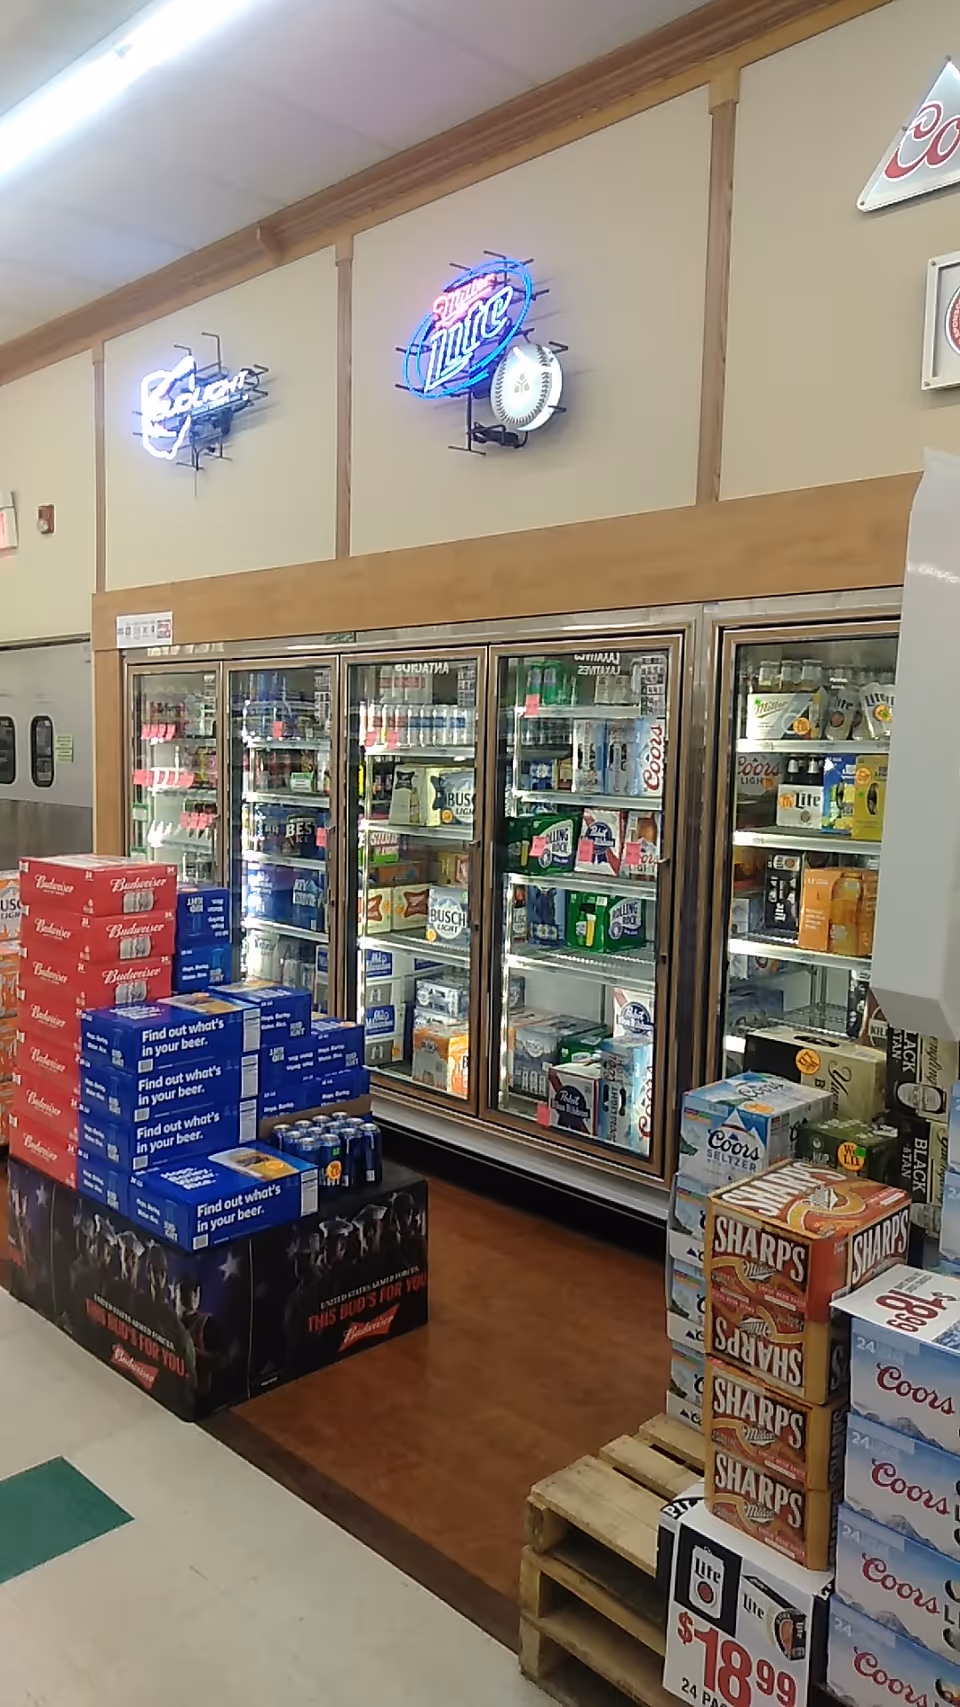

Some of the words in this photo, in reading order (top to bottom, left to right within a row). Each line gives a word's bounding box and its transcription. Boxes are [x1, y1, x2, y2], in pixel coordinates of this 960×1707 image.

[424, 285, 513, 393] Lite
[643, 724, 663, 791] Coors
[740, 776, 763, 785] LIGH
[447, 793, 472, 807] BUS
[794, 792, 821, 809] Lite
[35, 874, 74, 893] Budweiser
[110, 877, 166, 893] Budweiser
[430, 909, 466, 928] BUSCH
[775, 902, 786, 921] Lite
[35, 918, 71, 939] Budweiser
[106, 922, 164, 938] Budweiser
[33, 961, 68, 983] Budweiser
[102, 967, 161, 984] Budweiser
[31, 1003, 66, 1028] Budweiser
[142, 1027, 167, 1043] Find
[168, 1024, 187, 1038] out
[188, 1018, 224, 1035] what's
[30, 1047, 66, 1072] Budweiser
[142, 1044, 153, 1057] in
[155, 1041, 180, 1057] your
[181, 1037, 208, 1050] beer.
[903, 1029, 918, 1073] LACK
[138, 1076, 163, 1092] Find
[165, 1073, 183, 1087] out
[185, 1065, 221, 1082] what's
[27, 1089, 61, 1116] Budweiser
[138, 1094, 149, 1106] in
[151, 1089, 176, 1105] your
[178, 1084, 205, 1098] beer.
[560, 1090, 580, 1106] Pabst
[566, 1105, 589, 1118] Ribbon
[137, 1123, 161, 1140] Find
[163, 1120, 182, 1134] out
[184, 1111, 220, 1129] what's
[24, 1133, 58, 1161] Budweiser
[137, 1141, 147, 1154] in
[150, 1137, 174, 1153] your
[177, 1130, 203, 1145] beer.
[708, 1129, 760, 1161] Coors
[707, 1149, 757, 1172] SELTZER
[901, 1153, 912, 1179] TAN
[912, 1137, 928, 1194] BLACK
[197, 1201, 222, 1217] Find
[224, 1195, 243, 1210] out
[244, 1184, 281, 1205] what's
[197, 1220, 208, 1232] in
[210, 1213, 235, 1233] your
[237, 1205, 265, 1221] beer.
[715, 1215, 805, 1283] SHARP'S
[852, 1209, 909, 1285] SHARP'S
[309, 1308, 336, 1332] THIS
[380, 1281, 402, 1303] FOR
[343, 1315, 394, 1344] Budweiser
[139, 1333, 159, 1361] FOR
[715, 1316, 802, 1386] SHARP'S
[856, 1337, 875, 1354] 24
[113, 1345, 154, 1382] Budweiser
[876, 1363, 955, 1415] Coors
[714, 1379, 803, 1449] SHARP'S
[851, 1431, 870, 1449] 24
[715, 1454, 802, 1528] SHARP'S
[871, 1458, 950, 1515] Coors
[842, 1525, 861, 1543] 24
[695, 1557, 721, 1584] Lite
[862, 1552, 940, 1614] Coors
[743, 1593, 765, 1620] Lite
[834, 1617, 851, 1637] 24
[681, 1677, 698, 1699] 24
[854, 1646, 929, 1707] Coors
